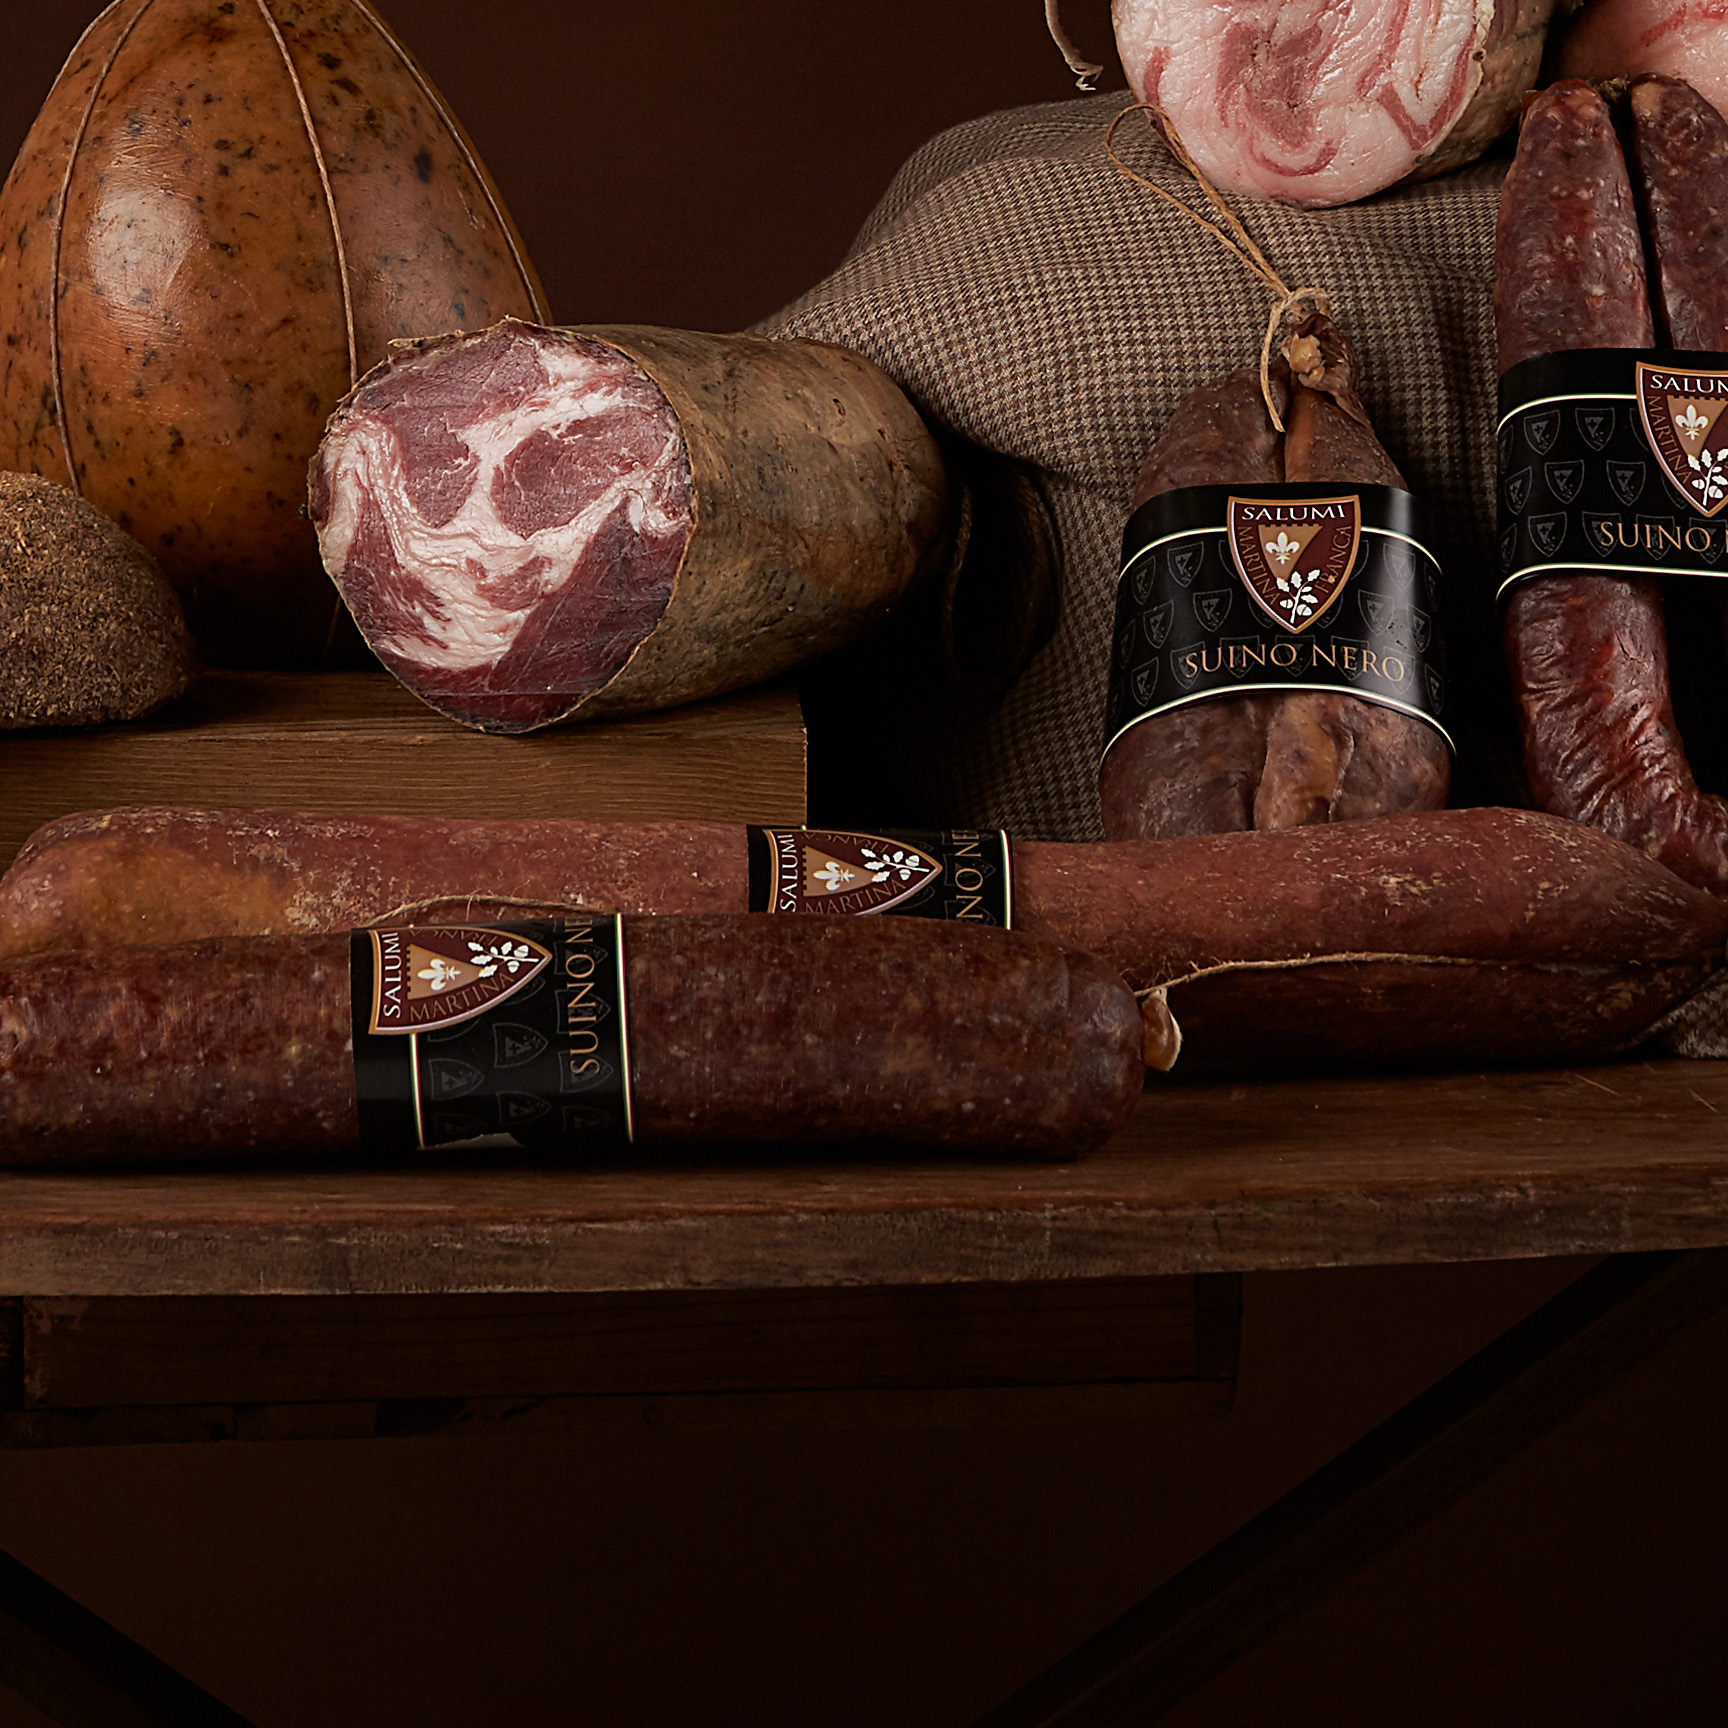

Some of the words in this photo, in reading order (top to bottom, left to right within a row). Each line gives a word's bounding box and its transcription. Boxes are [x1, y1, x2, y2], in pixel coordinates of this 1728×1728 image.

[1647, 395, 1692, 484] MARTINA
[1241, 504, 1346, 521] SALUMI
[1599, 521, 1711, 552] SUINO
[1237, 525, 1281, 605] MARTINA
[1314, 525, 1352, 594] FRANCA
[1185, 643, 1297, 678] SUINO
[1312, 643, 1405, 682] NERO
[951, 829, 983, 858] NE
[778, 834, 799, 913] SALUMI
[804, 879, 907, 913] MARTINA
[382, 932, 401, 1019] SALUMI
[408, 972, 515, 1022] MARTINA
[565, 953, 600, 1074] SUINO
